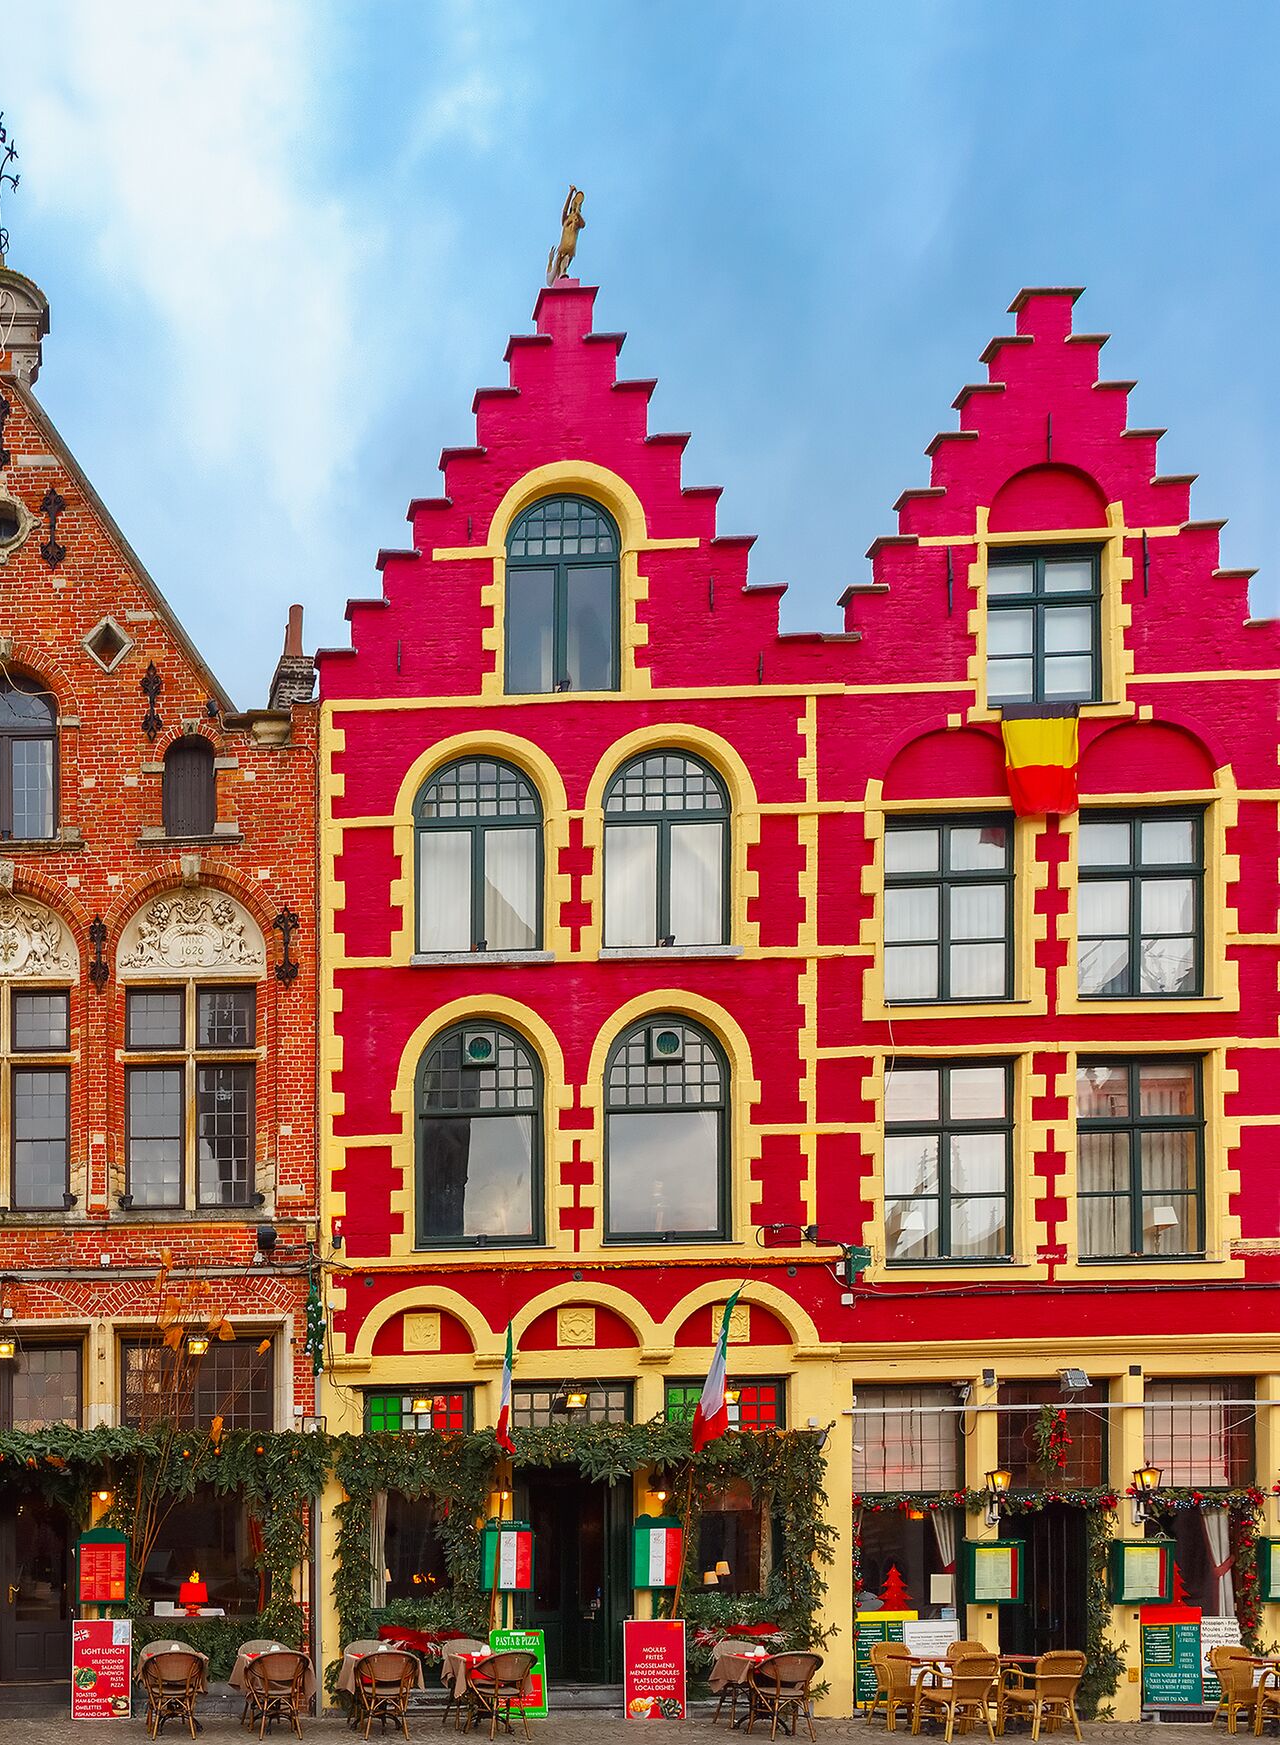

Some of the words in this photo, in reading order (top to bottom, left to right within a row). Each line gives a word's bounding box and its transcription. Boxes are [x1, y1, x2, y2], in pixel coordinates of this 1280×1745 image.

[182, 946, 204, 955] 1626
[496, 1637, 515, 1645] PASTA
[516, 1637, 520, 1645] &
[522, 1637, 540, 1645] PIZZA
